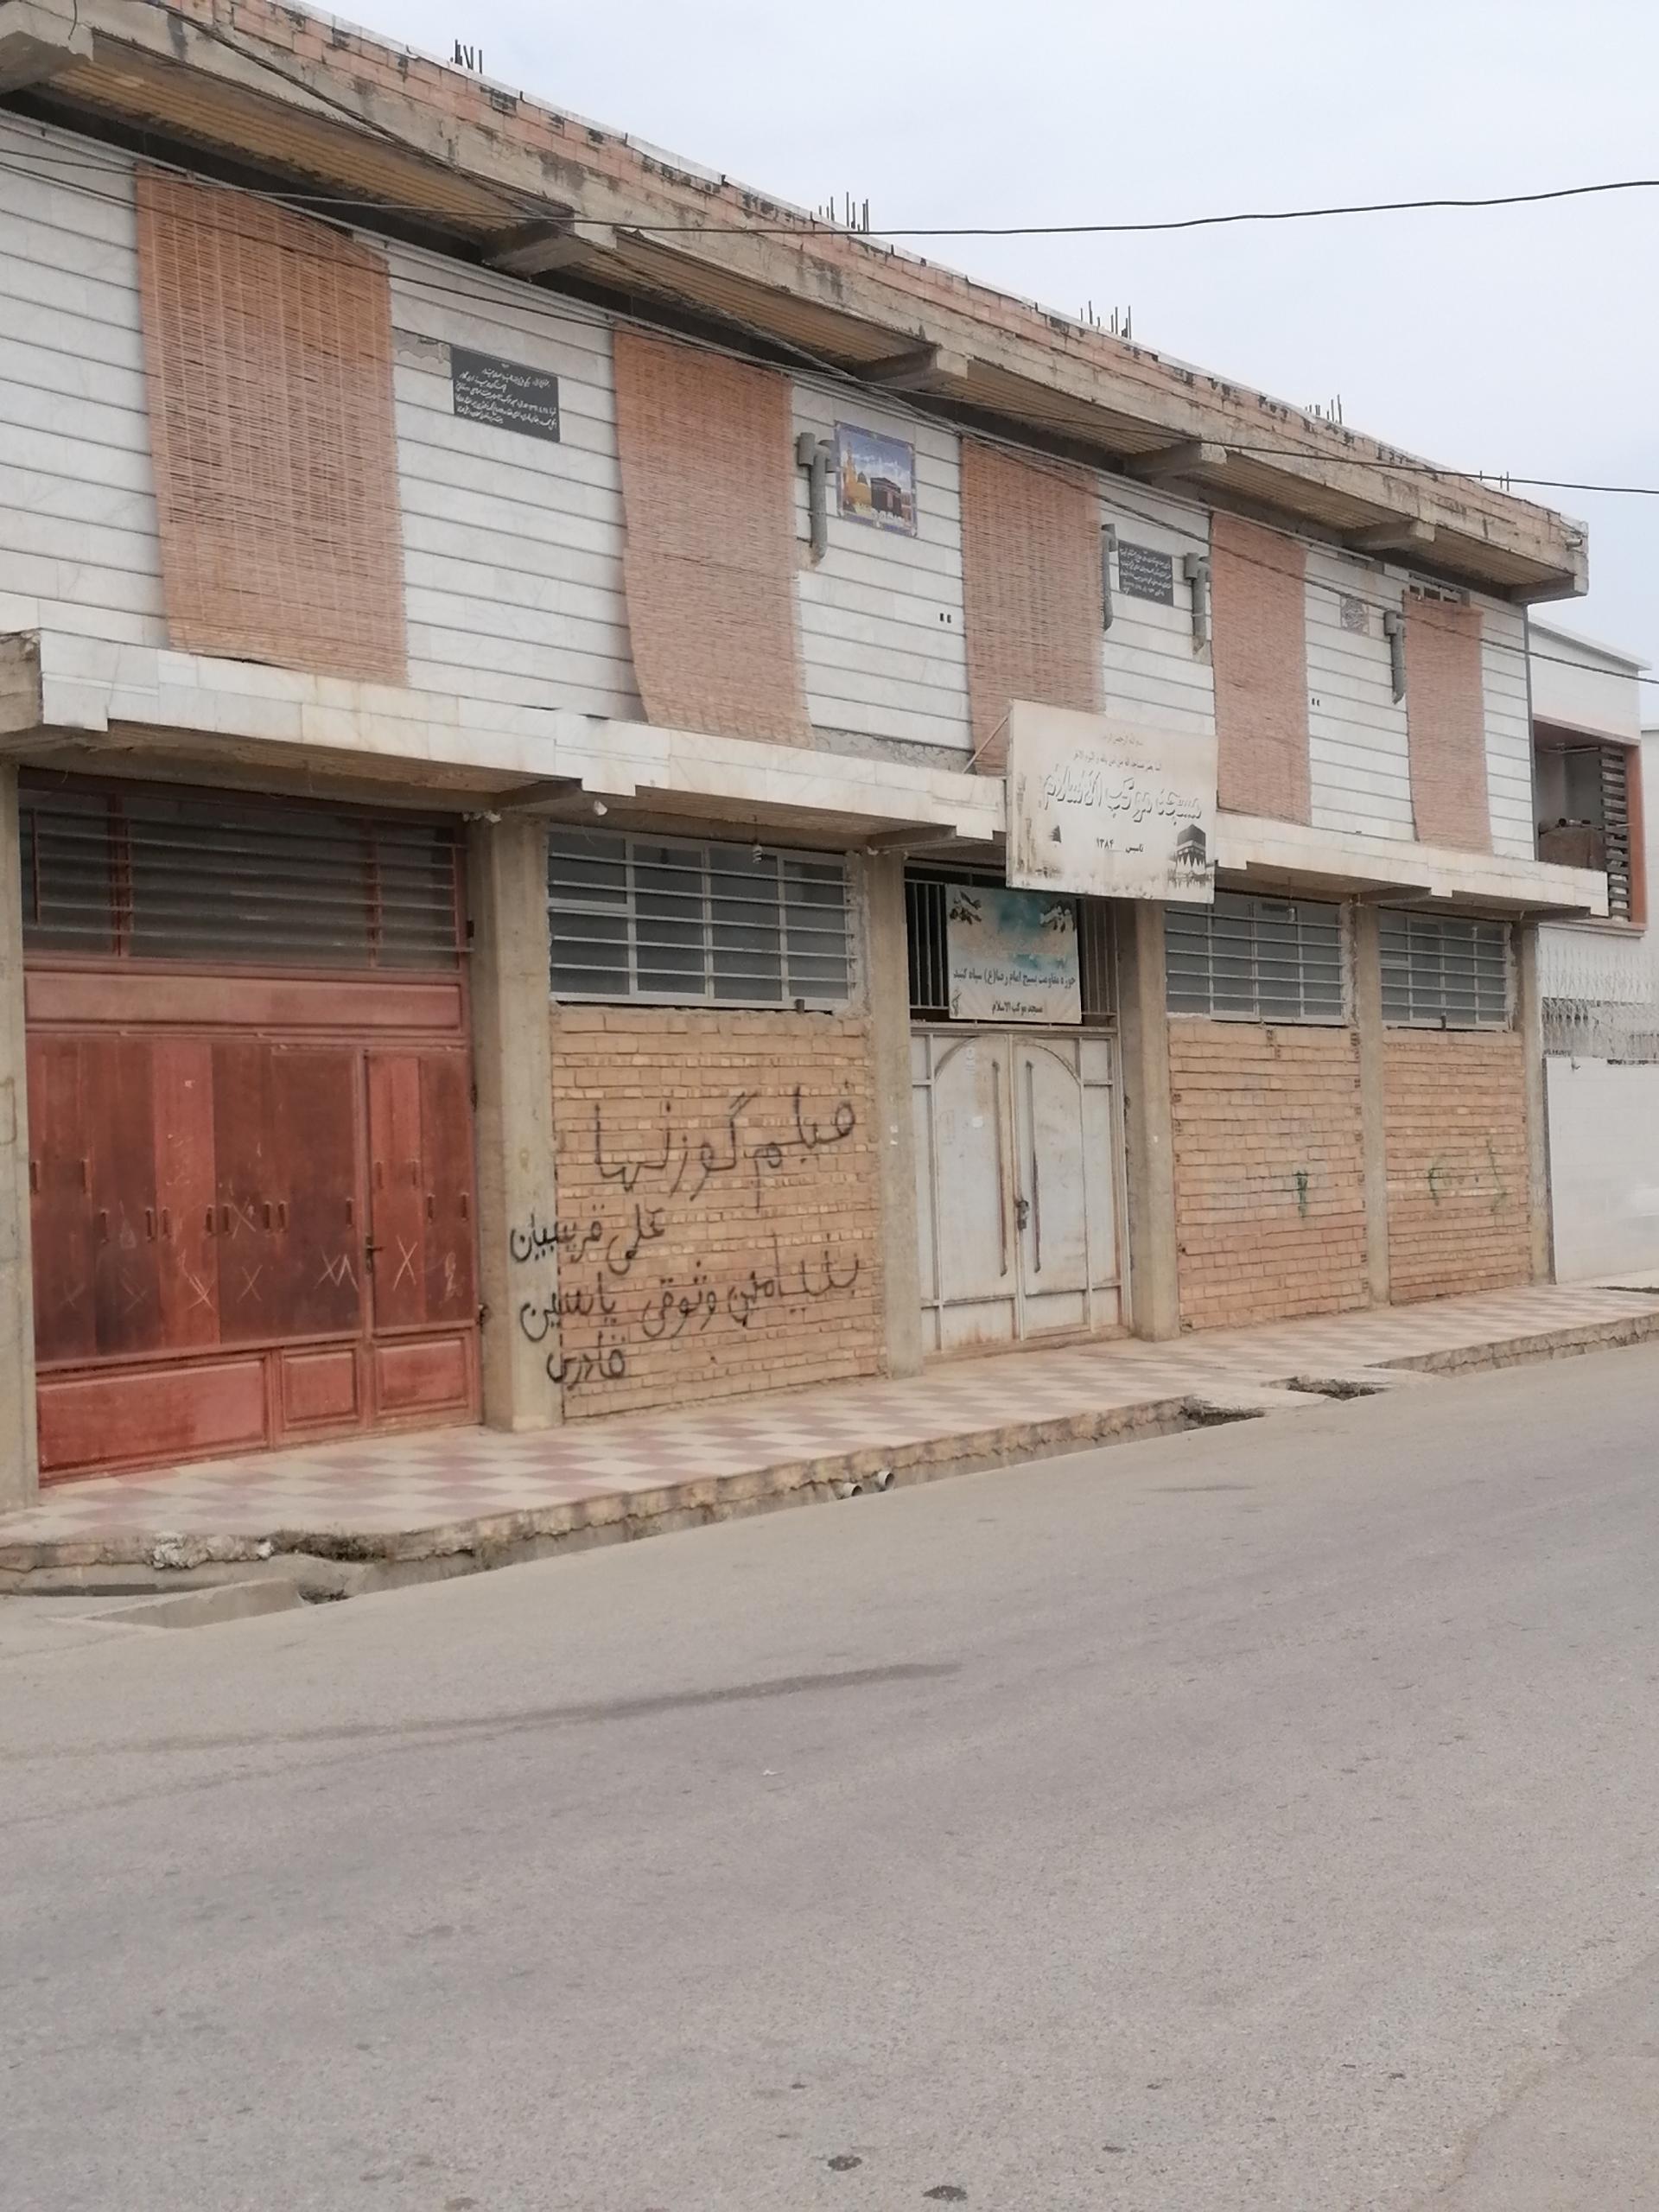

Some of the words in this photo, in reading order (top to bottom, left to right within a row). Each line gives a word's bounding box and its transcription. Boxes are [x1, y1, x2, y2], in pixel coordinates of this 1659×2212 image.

[1154, 788, 1202, 826] مسجد
[1027, 1004, 1043, 1015] مسجد
[607, 1204, 665, 1274] علی
